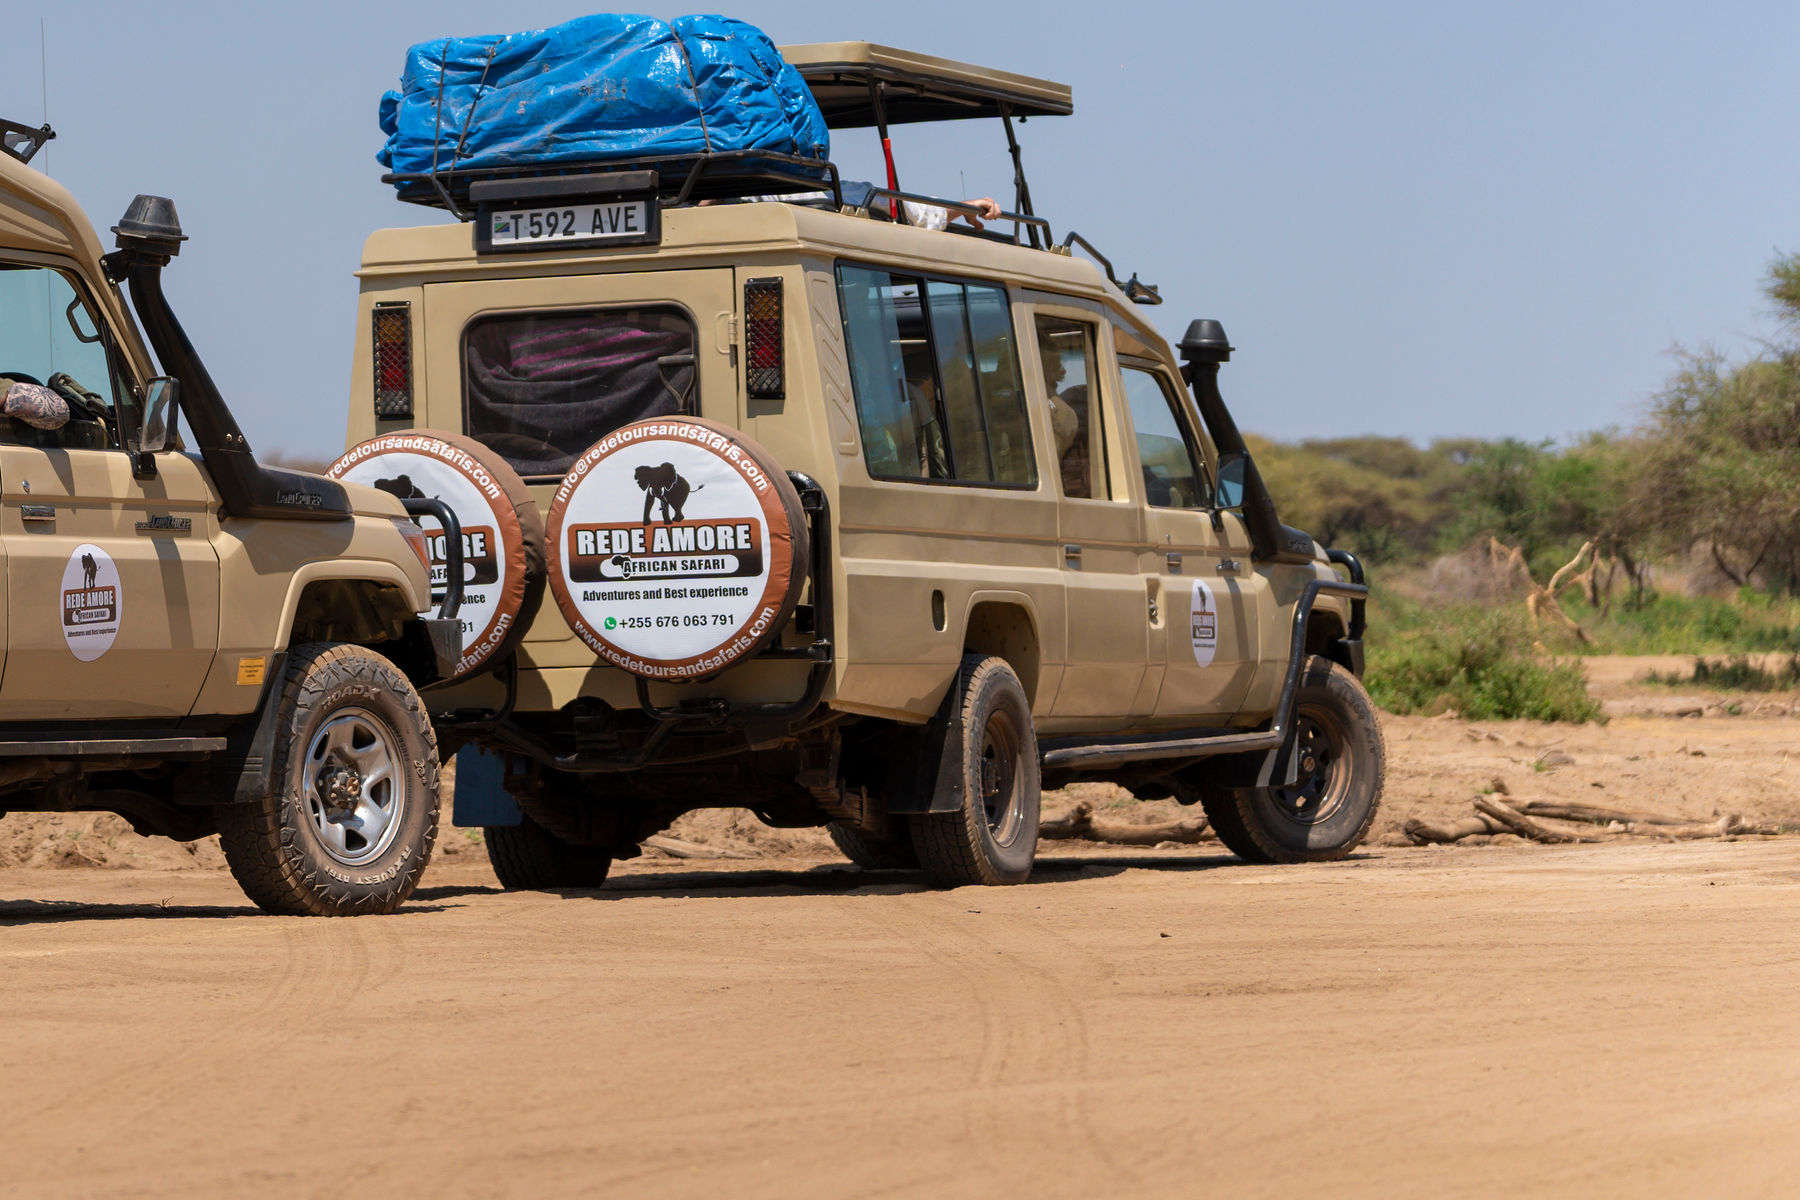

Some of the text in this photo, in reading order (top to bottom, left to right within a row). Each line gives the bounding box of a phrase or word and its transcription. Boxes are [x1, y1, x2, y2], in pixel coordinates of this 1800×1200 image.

[591, 206, 637, 234] AVE
[323, 437, 501, 499] redetoursandsafaris.com
[555, 423, 769, 503] info@redetoursandsafaris.com
[427, 531, 487, 561] ORE
[576, 524, 752, 555] REDE AMORE
[623, 559, 725, 574] AFRICAN SAFARI
[66, 590, 114, 609] REDE AMORE
[582, 585, 748, 601] Adventures and Best experience
[462, 621, 473, 632] 91
[619, 614, 735, 629] +255 676 063 791
[574, 606, 776, 677] www.redetoursandsafaris.com
